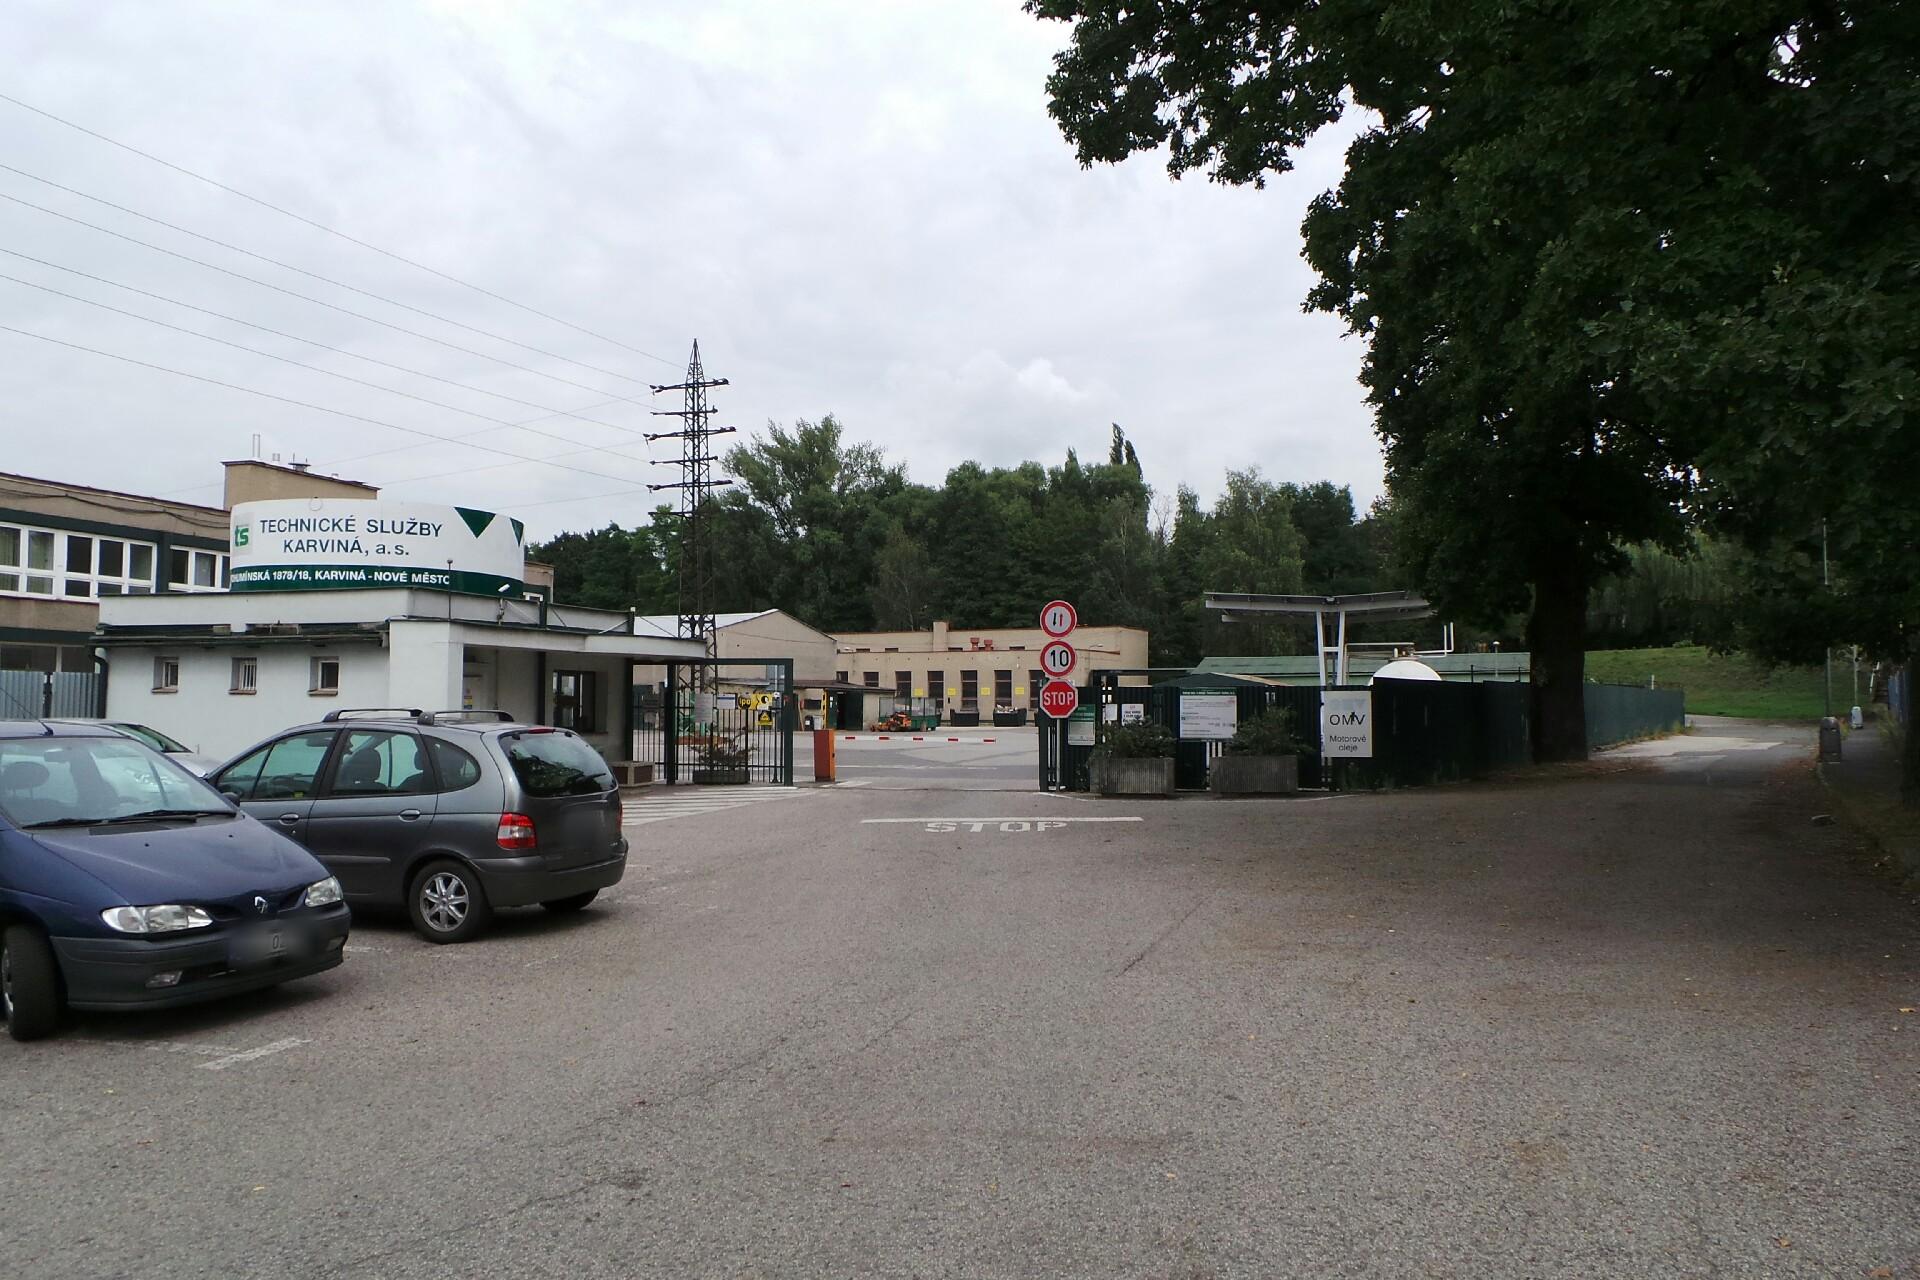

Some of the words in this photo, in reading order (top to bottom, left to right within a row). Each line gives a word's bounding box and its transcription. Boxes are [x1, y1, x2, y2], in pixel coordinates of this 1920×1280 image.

[260, 514, 356, 533] TECHNICKÉ
[366, 517, 443, 537] SLUŽBY
[283, 535, 369, 556] KARVINÁ,
[375, 543, 409, 556] a.s.
[314, 569, 367, 582] KARVINÁ
[373, 571, 408, 583] NOVÉ
[1050, 649, 1070, 667] 10
[1043, 691, 1075, 706] STOP
[1329, 712, 1366, 726] OMV
[1329, 735, 1367, 743] Motorové
[924, 821, 1068, 833] STOP
